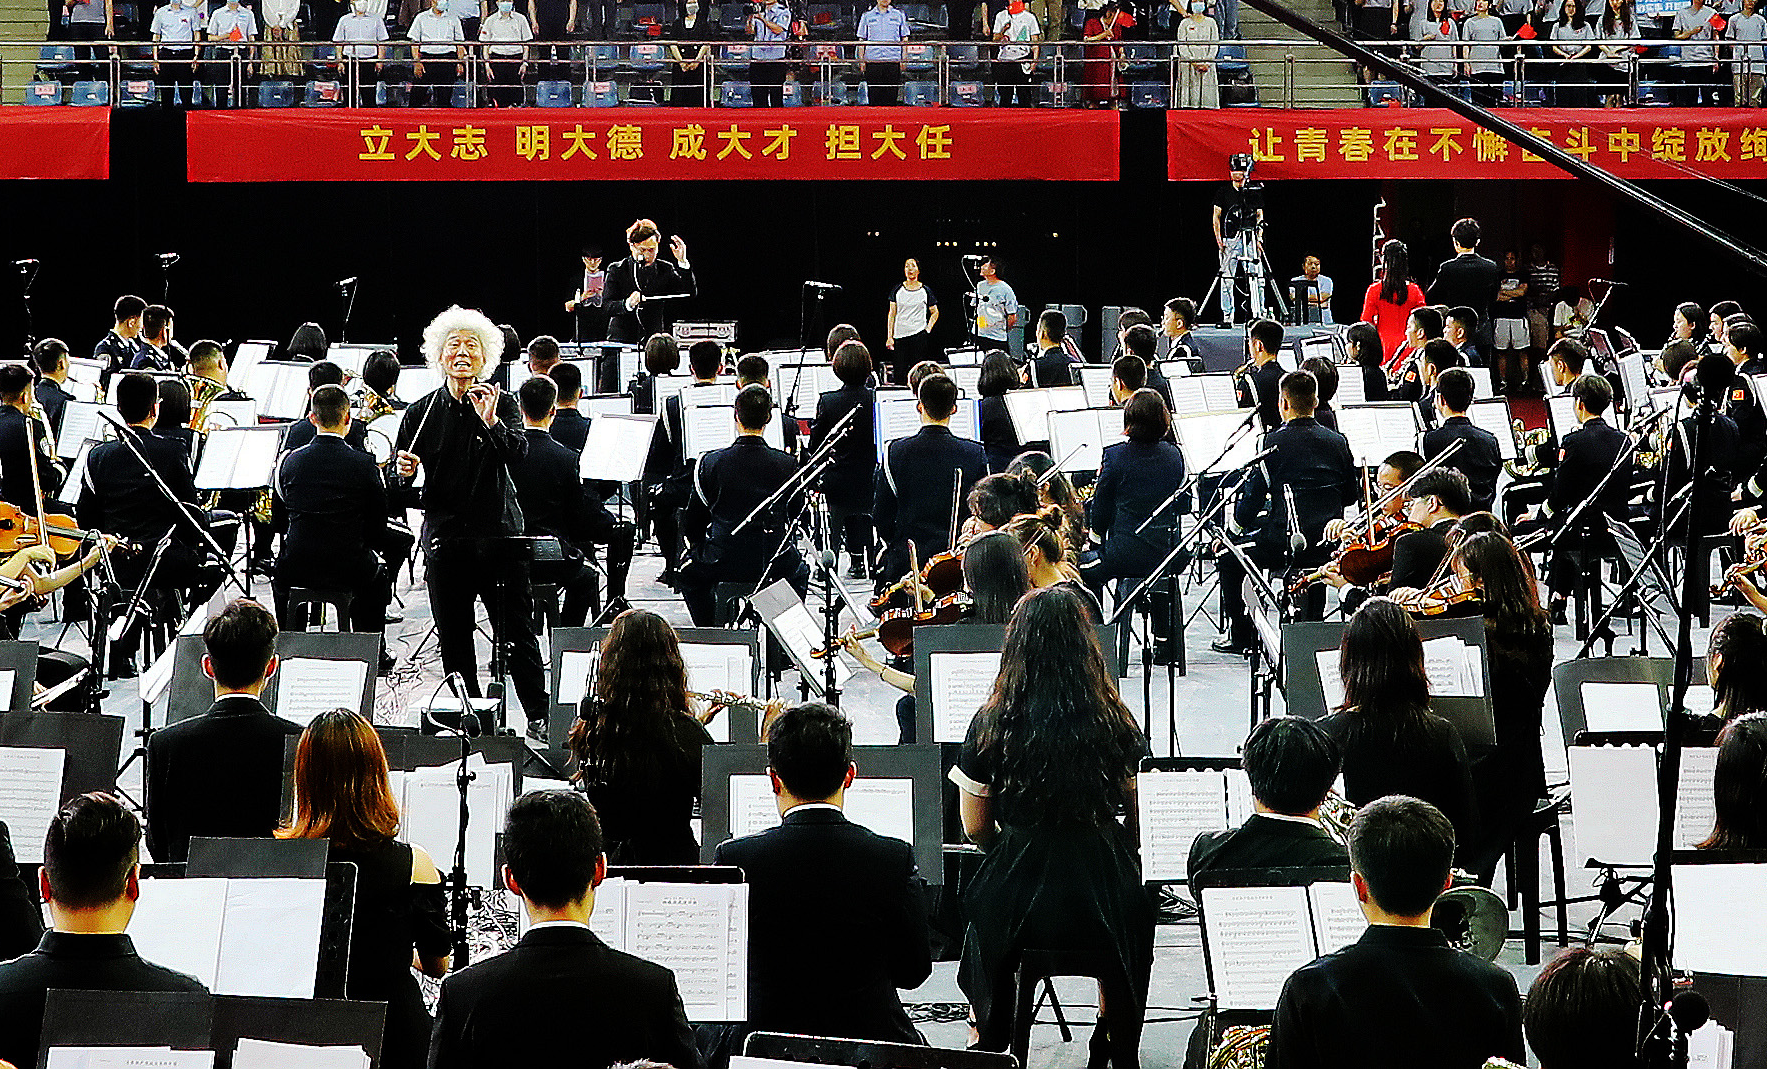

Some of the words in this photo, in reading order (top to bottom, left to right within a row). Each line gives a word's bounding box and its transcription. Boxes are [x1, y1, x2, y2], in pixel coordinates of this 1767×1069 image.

[358, 124, 489, 161] 立大志
[516, 123, 644, 161] 明大德
[669, 123, 799, 161] 成大才
[825, 123, 954, 161] 担大任
